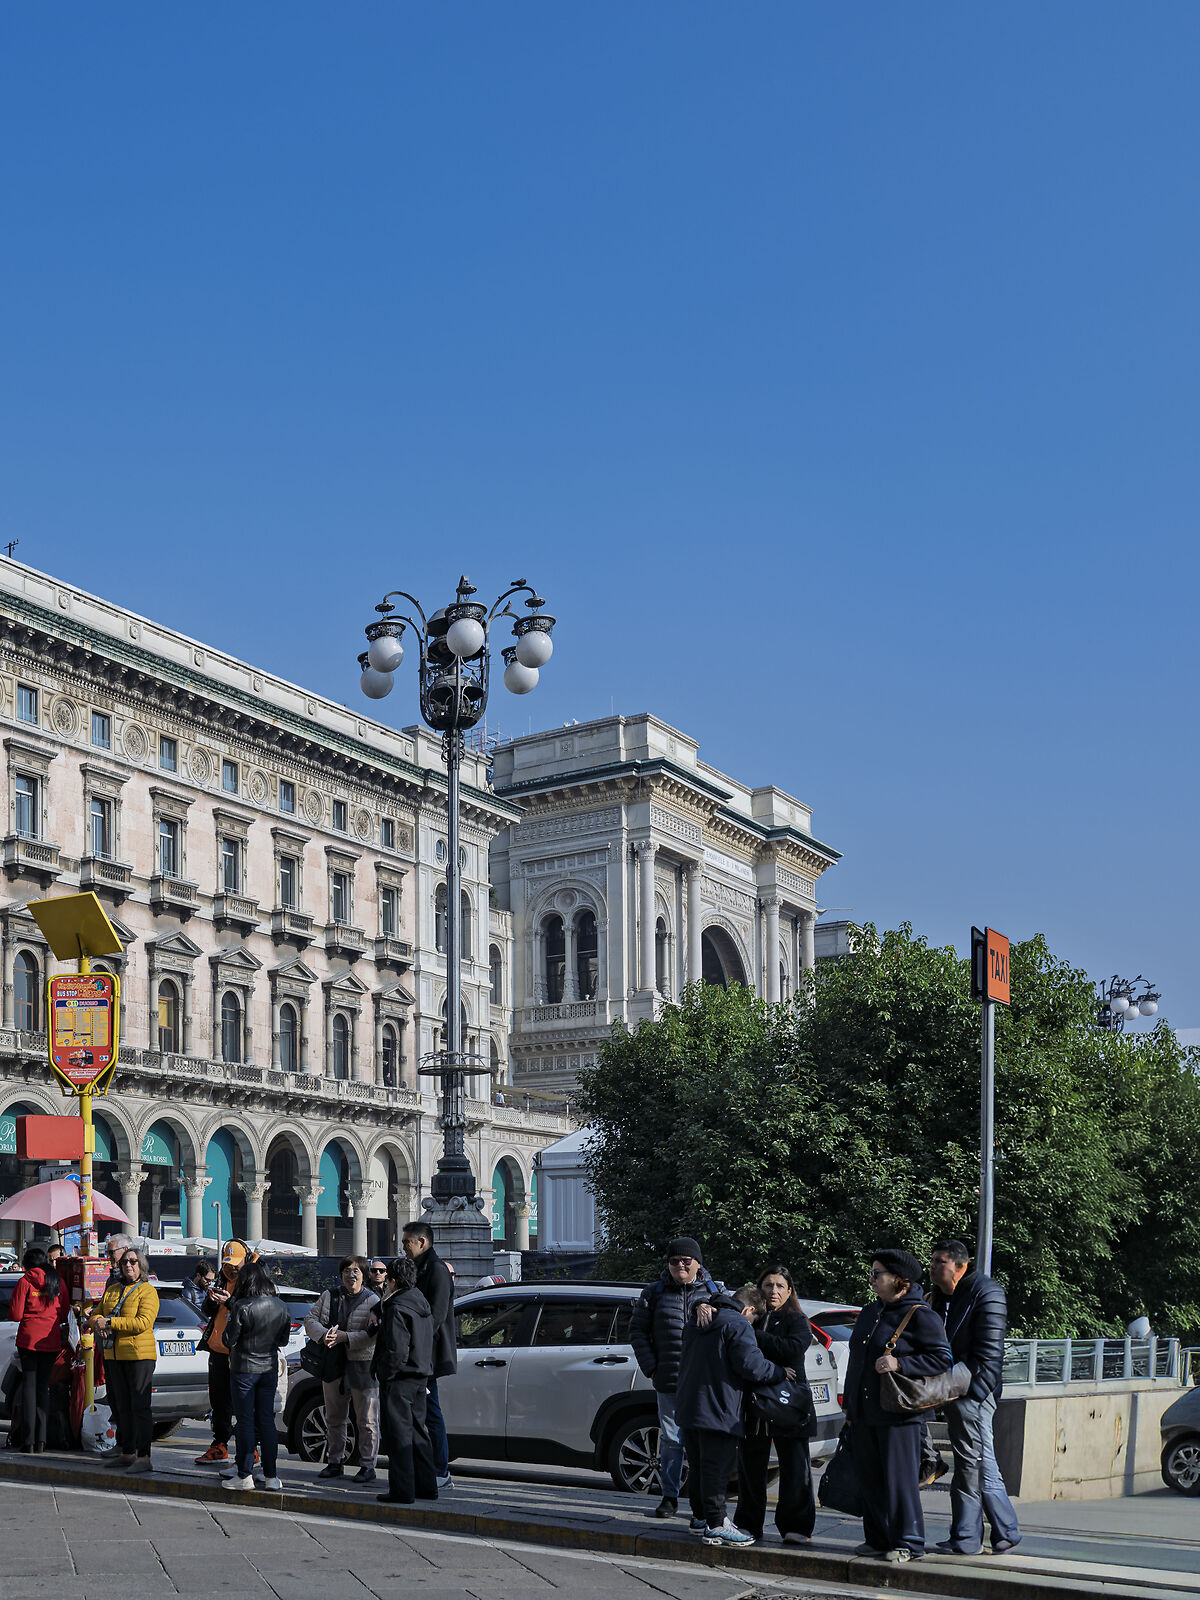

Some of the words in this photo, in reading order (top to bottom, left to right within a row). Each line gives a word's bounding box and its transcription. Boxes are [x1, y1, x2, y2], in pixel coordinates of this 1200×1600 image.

[990, 948, 1008, 985] TAXI
[92, 1152, 103, 1160] OSSI
[153, 1155, 168, 1163] ROSSI
